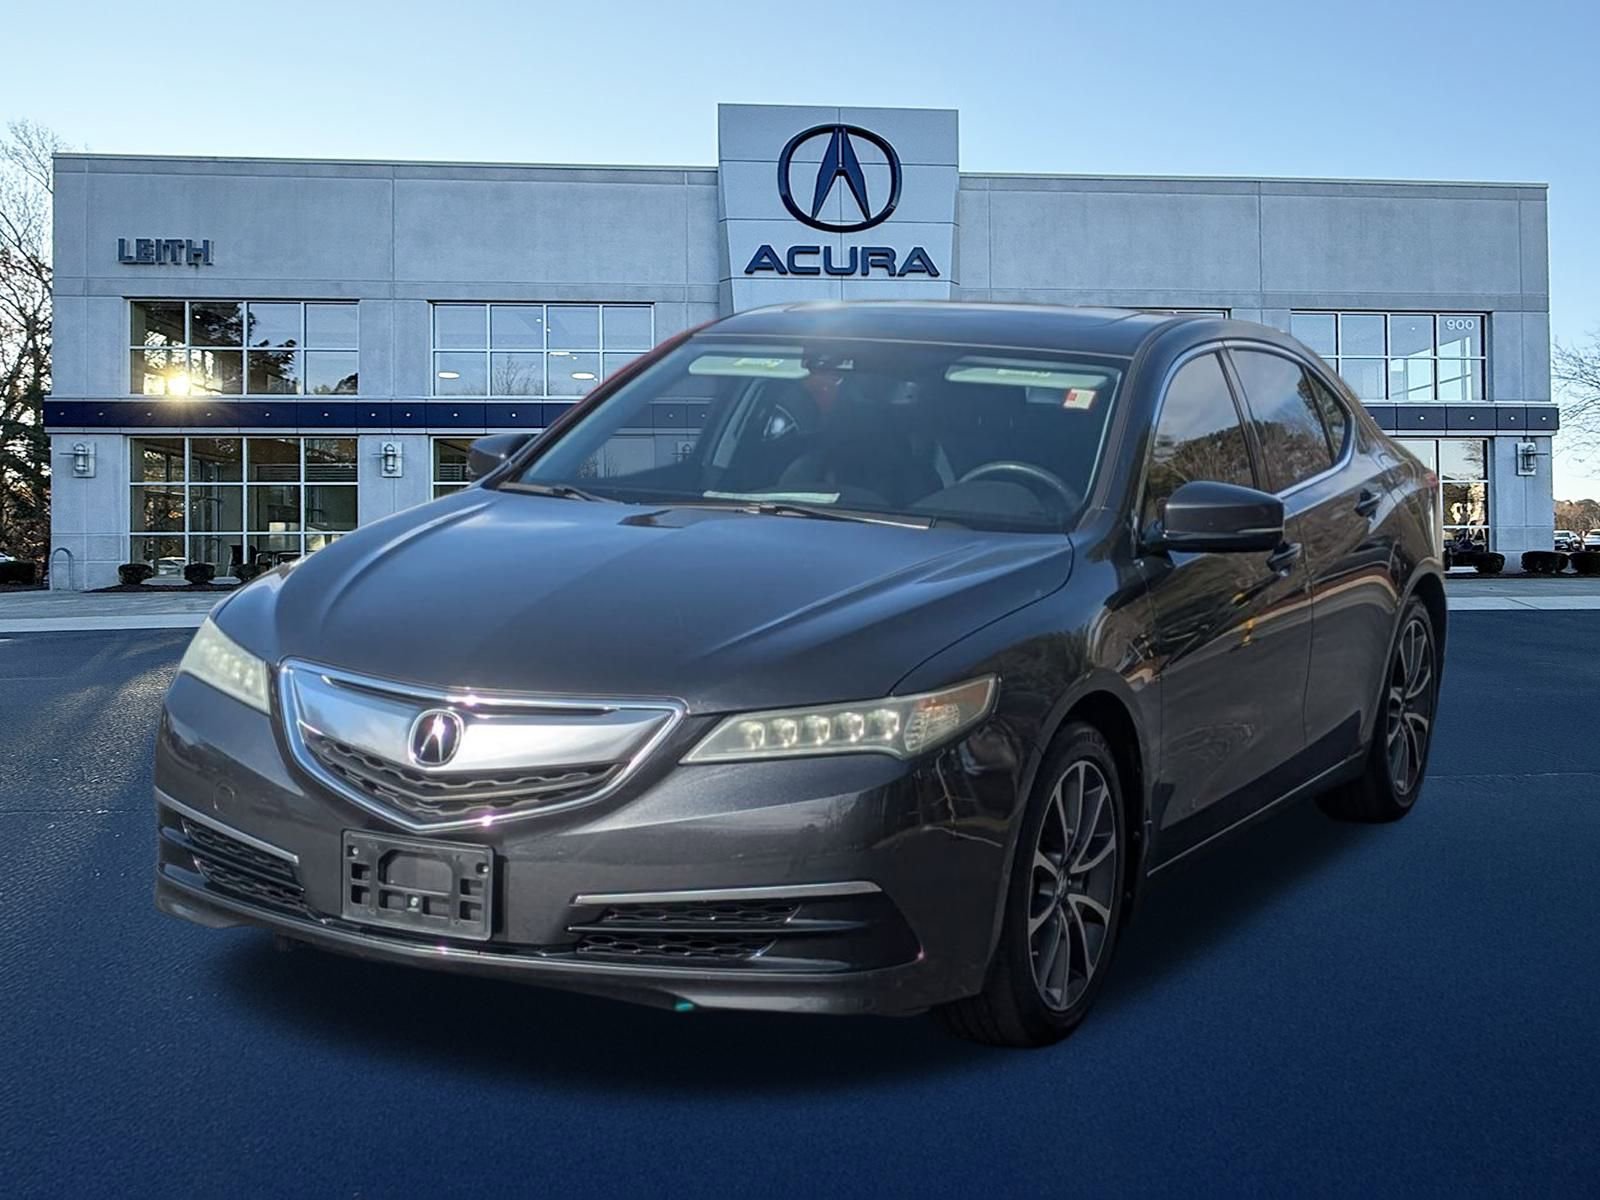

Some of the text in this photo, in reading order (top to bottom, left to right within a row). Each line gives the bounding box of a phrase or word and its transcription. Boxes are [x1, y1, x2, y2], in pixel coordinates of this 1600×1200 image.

[118, 238, 213, 265] LEITH
[744, 244, 940, 277] ACURA
[1446, 319, 1474, 330] 900
